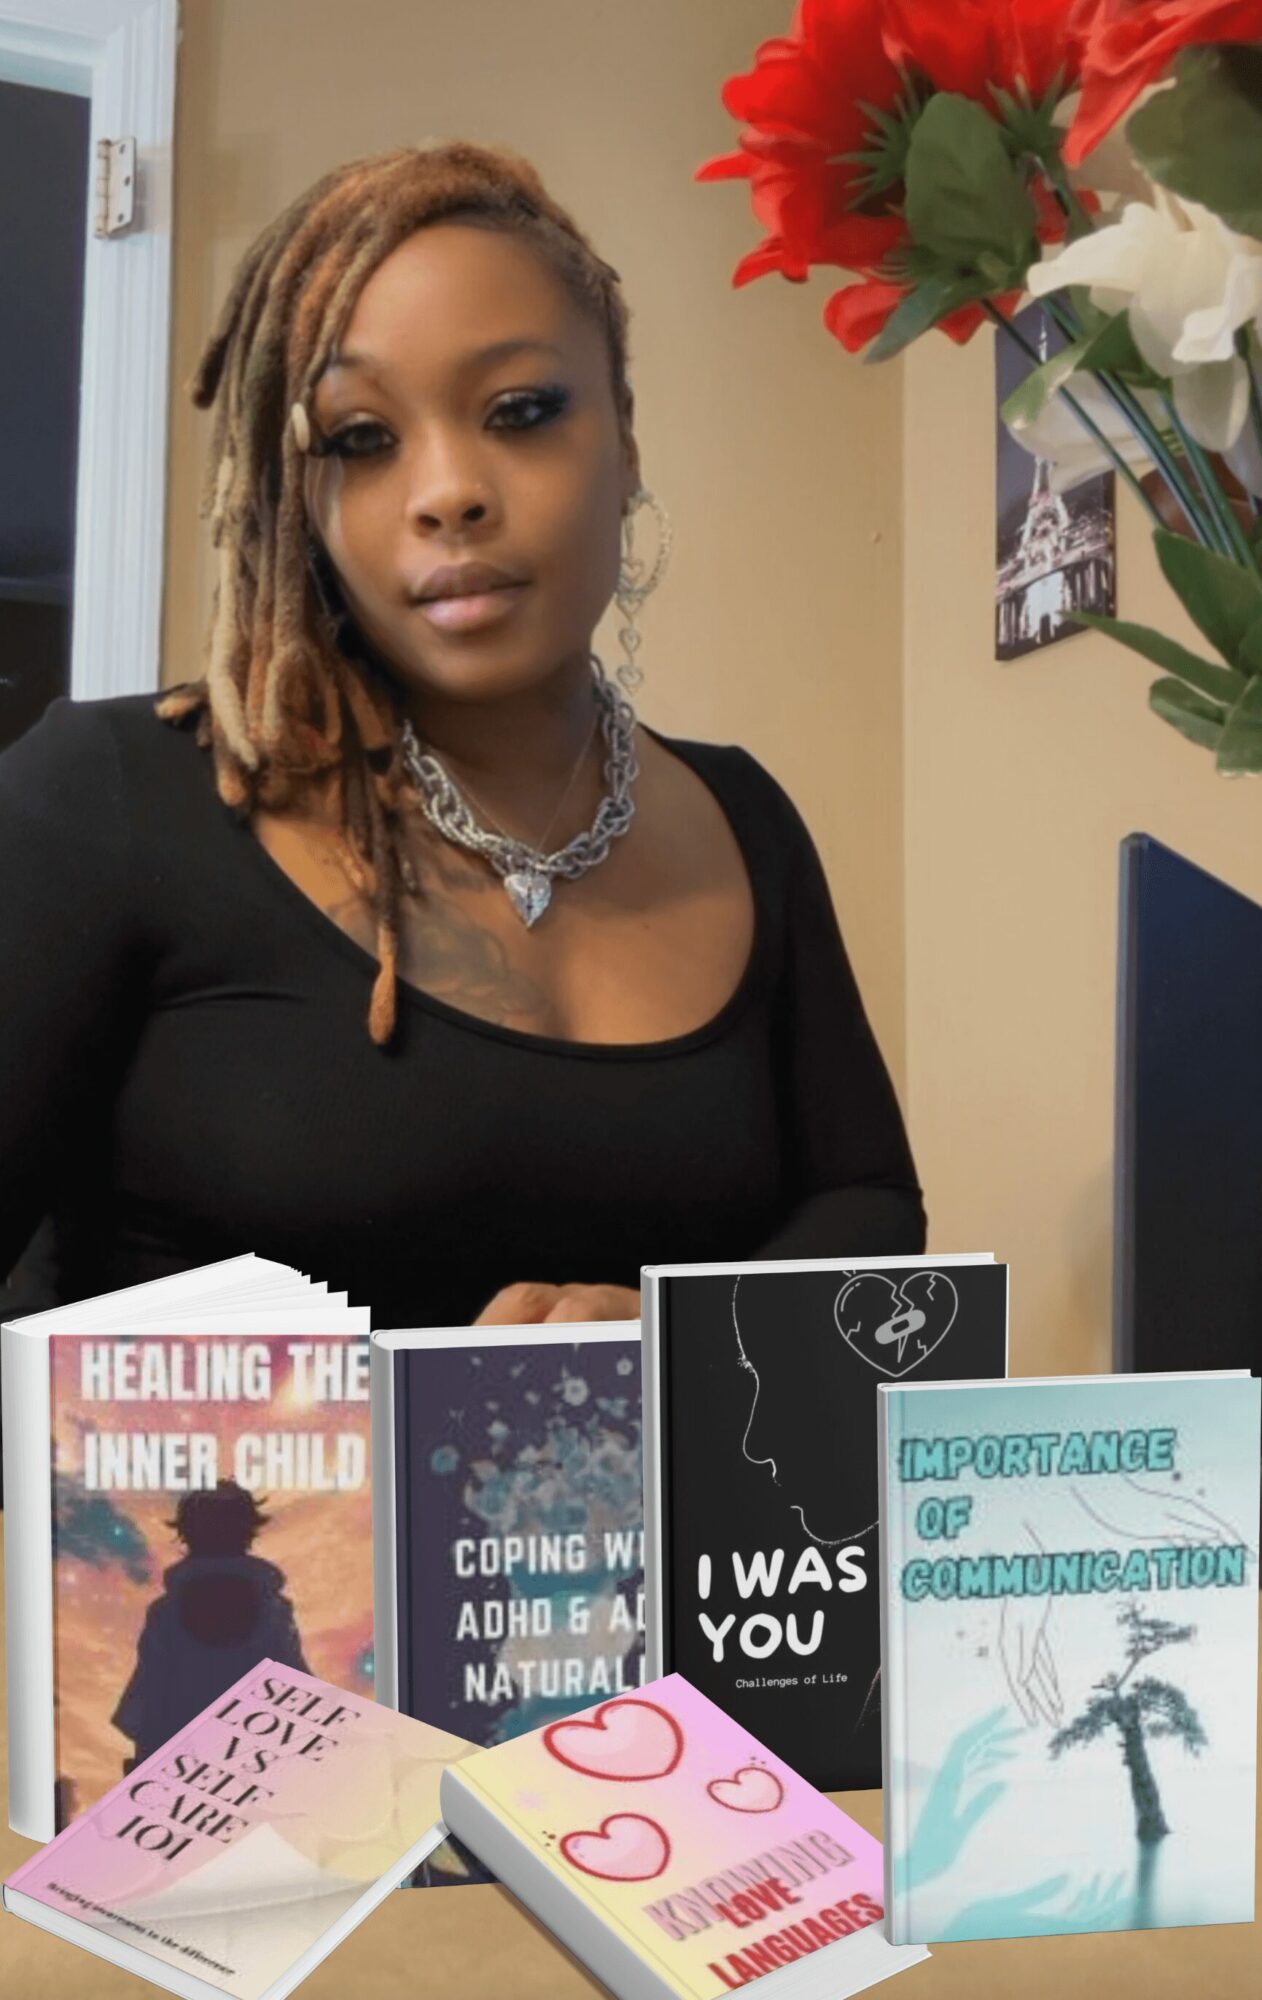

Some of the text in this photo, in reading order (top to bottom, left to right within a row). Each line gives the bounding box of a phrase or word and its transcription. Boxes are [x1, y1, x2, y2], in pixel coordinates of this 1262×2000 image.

[81, 1341, 369, 1401] HEALING THE
[85, 1432, 366, 1491] INNER CHILD
[899, 1428, 1177, 1482] IMPORTANCE
[916, 1496, 972, 1540] OF
[455, 1534, 586, 1577] COPING
[698, 1545, 867, 1600] I WAS
[901, 1546, 1248, 1602] COMMUNICATION
[456, 1598, 552, 1641] ADHD
[568, 1596, 590, 1635] &
[698, 1609, 825, 1663] YOU
[250, 1677, 361, 1727] SELF
[735, 1673, 848, 1689] Challenges of Life
[215, 1699, 339, 1762] LOVE
[222, 1736, 279, 1774] VS
[161, 1753, 275, 1807] SELF
[128, 1780, 249, 1844] CARE
[642, 1829, 856, 1942] KNOWING
[714, 1876, 802, 1929] LOVE
[160, 1936, 179, 1949] the
[707, 1892, 885, 1991] LANGUAGES
